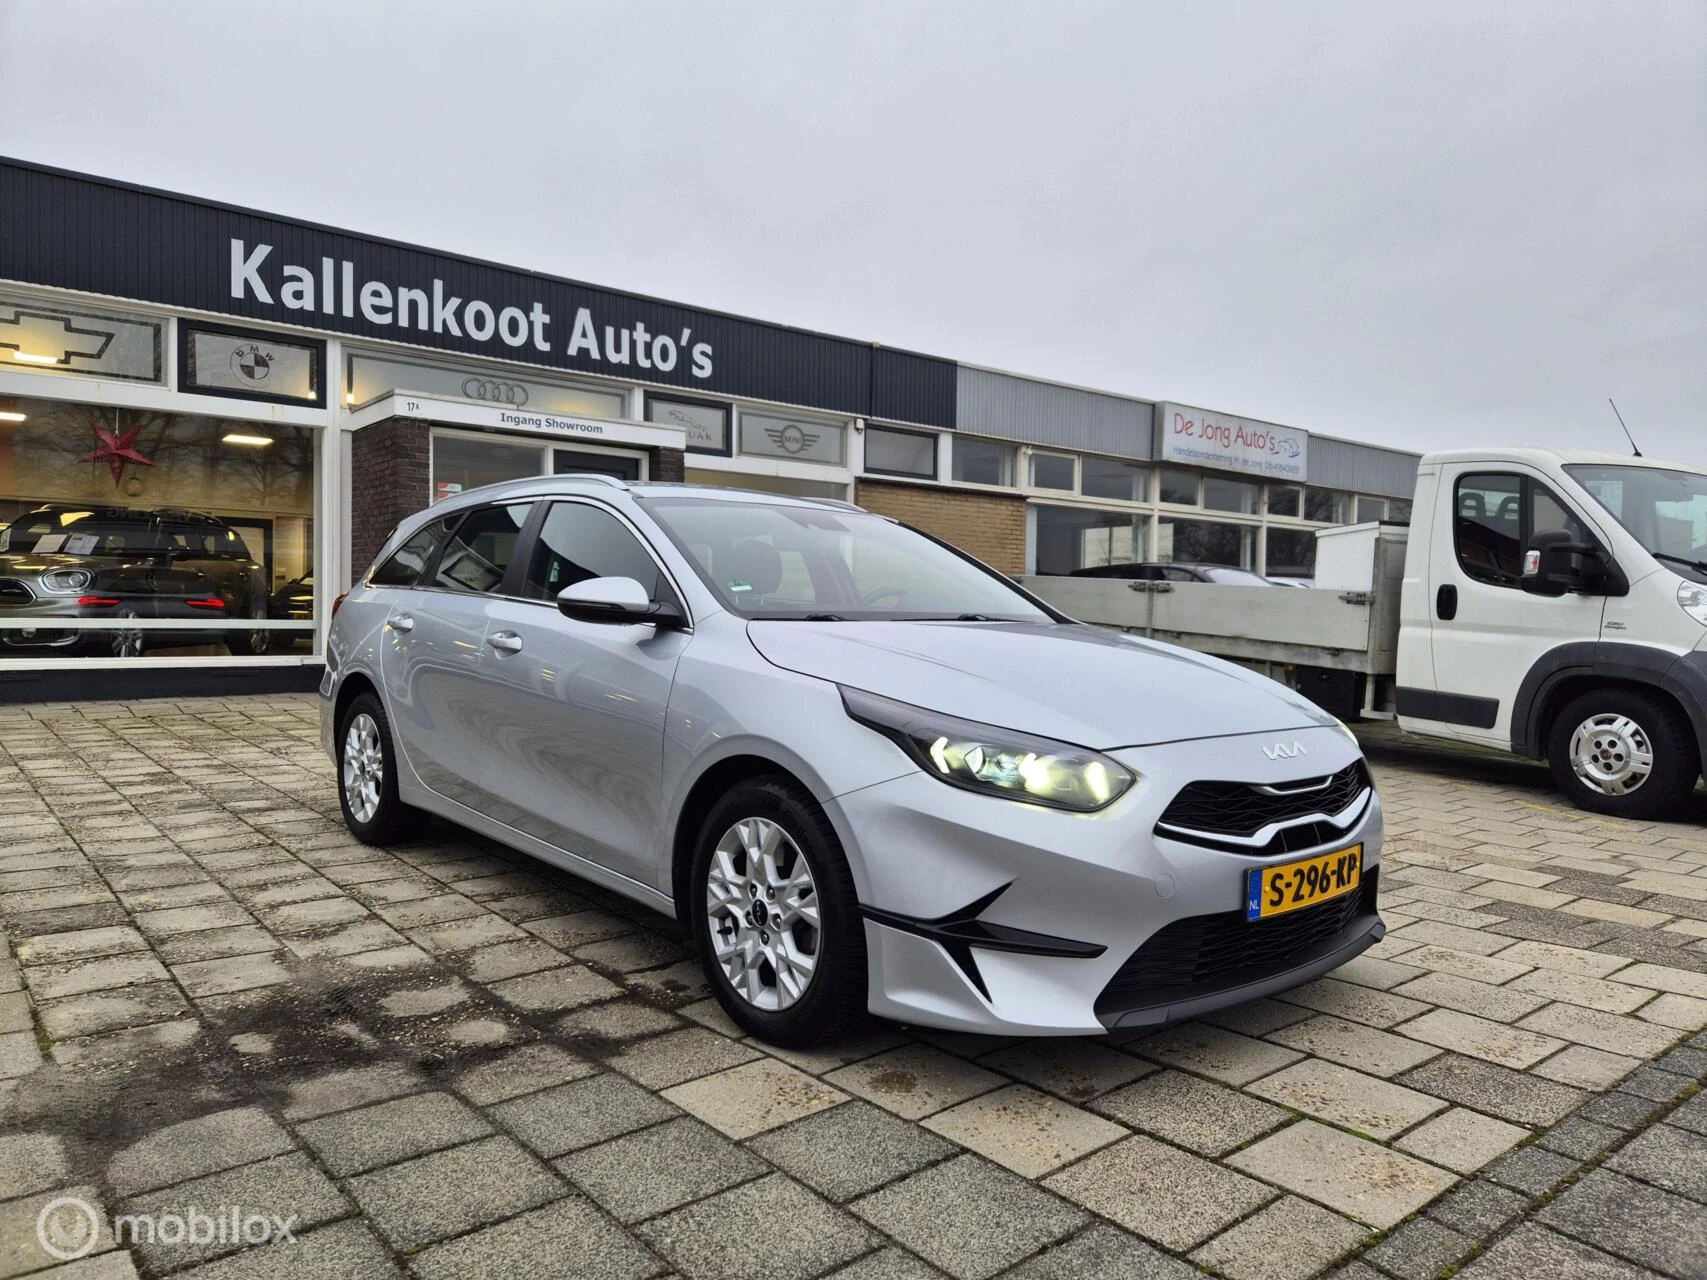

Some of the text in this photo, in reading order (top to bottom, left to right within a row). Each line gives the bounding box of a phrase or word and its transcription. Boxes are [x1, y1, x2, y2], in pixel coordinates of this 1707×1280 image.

[230, 237, 714, 379] Kallenkoot Auto's
[235, 344, 275, 362] BMW
[500, 412, 603, 434] Ingang Showroom
[1174, 413, 1276, 451] De Jong Auto's
[784, 434, 801, 445] MINI
[1269, 852, 1358, 907] S-296-KP
[1249, 899, 1260, 911] NL
